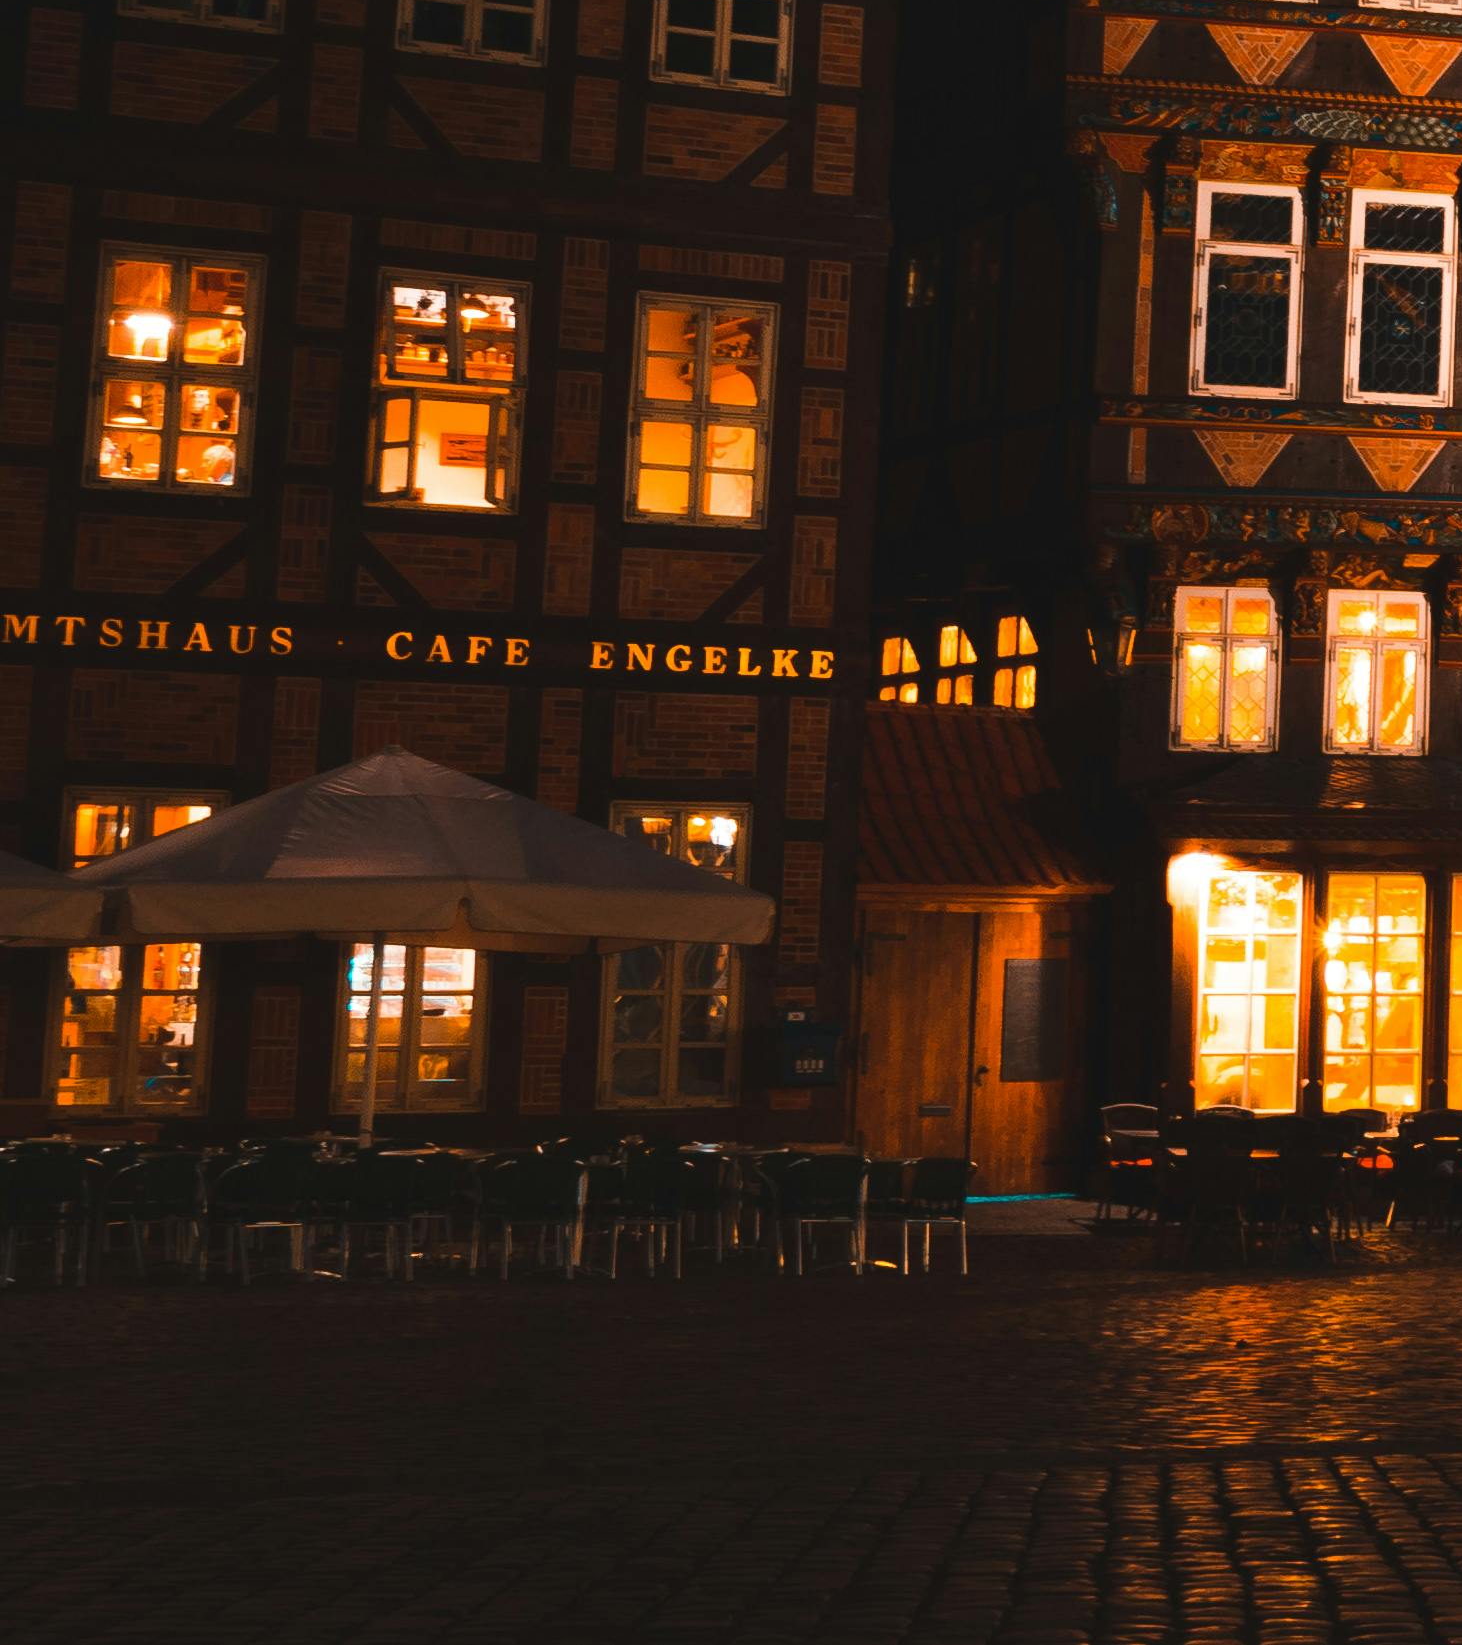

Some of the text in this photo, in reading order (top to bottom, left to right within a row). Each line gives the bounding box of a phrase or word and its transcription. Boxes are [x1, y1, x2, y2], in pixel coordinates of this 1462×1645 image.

[1, 614, 835, 679] MTSHAUS CAFE ENGELKE
